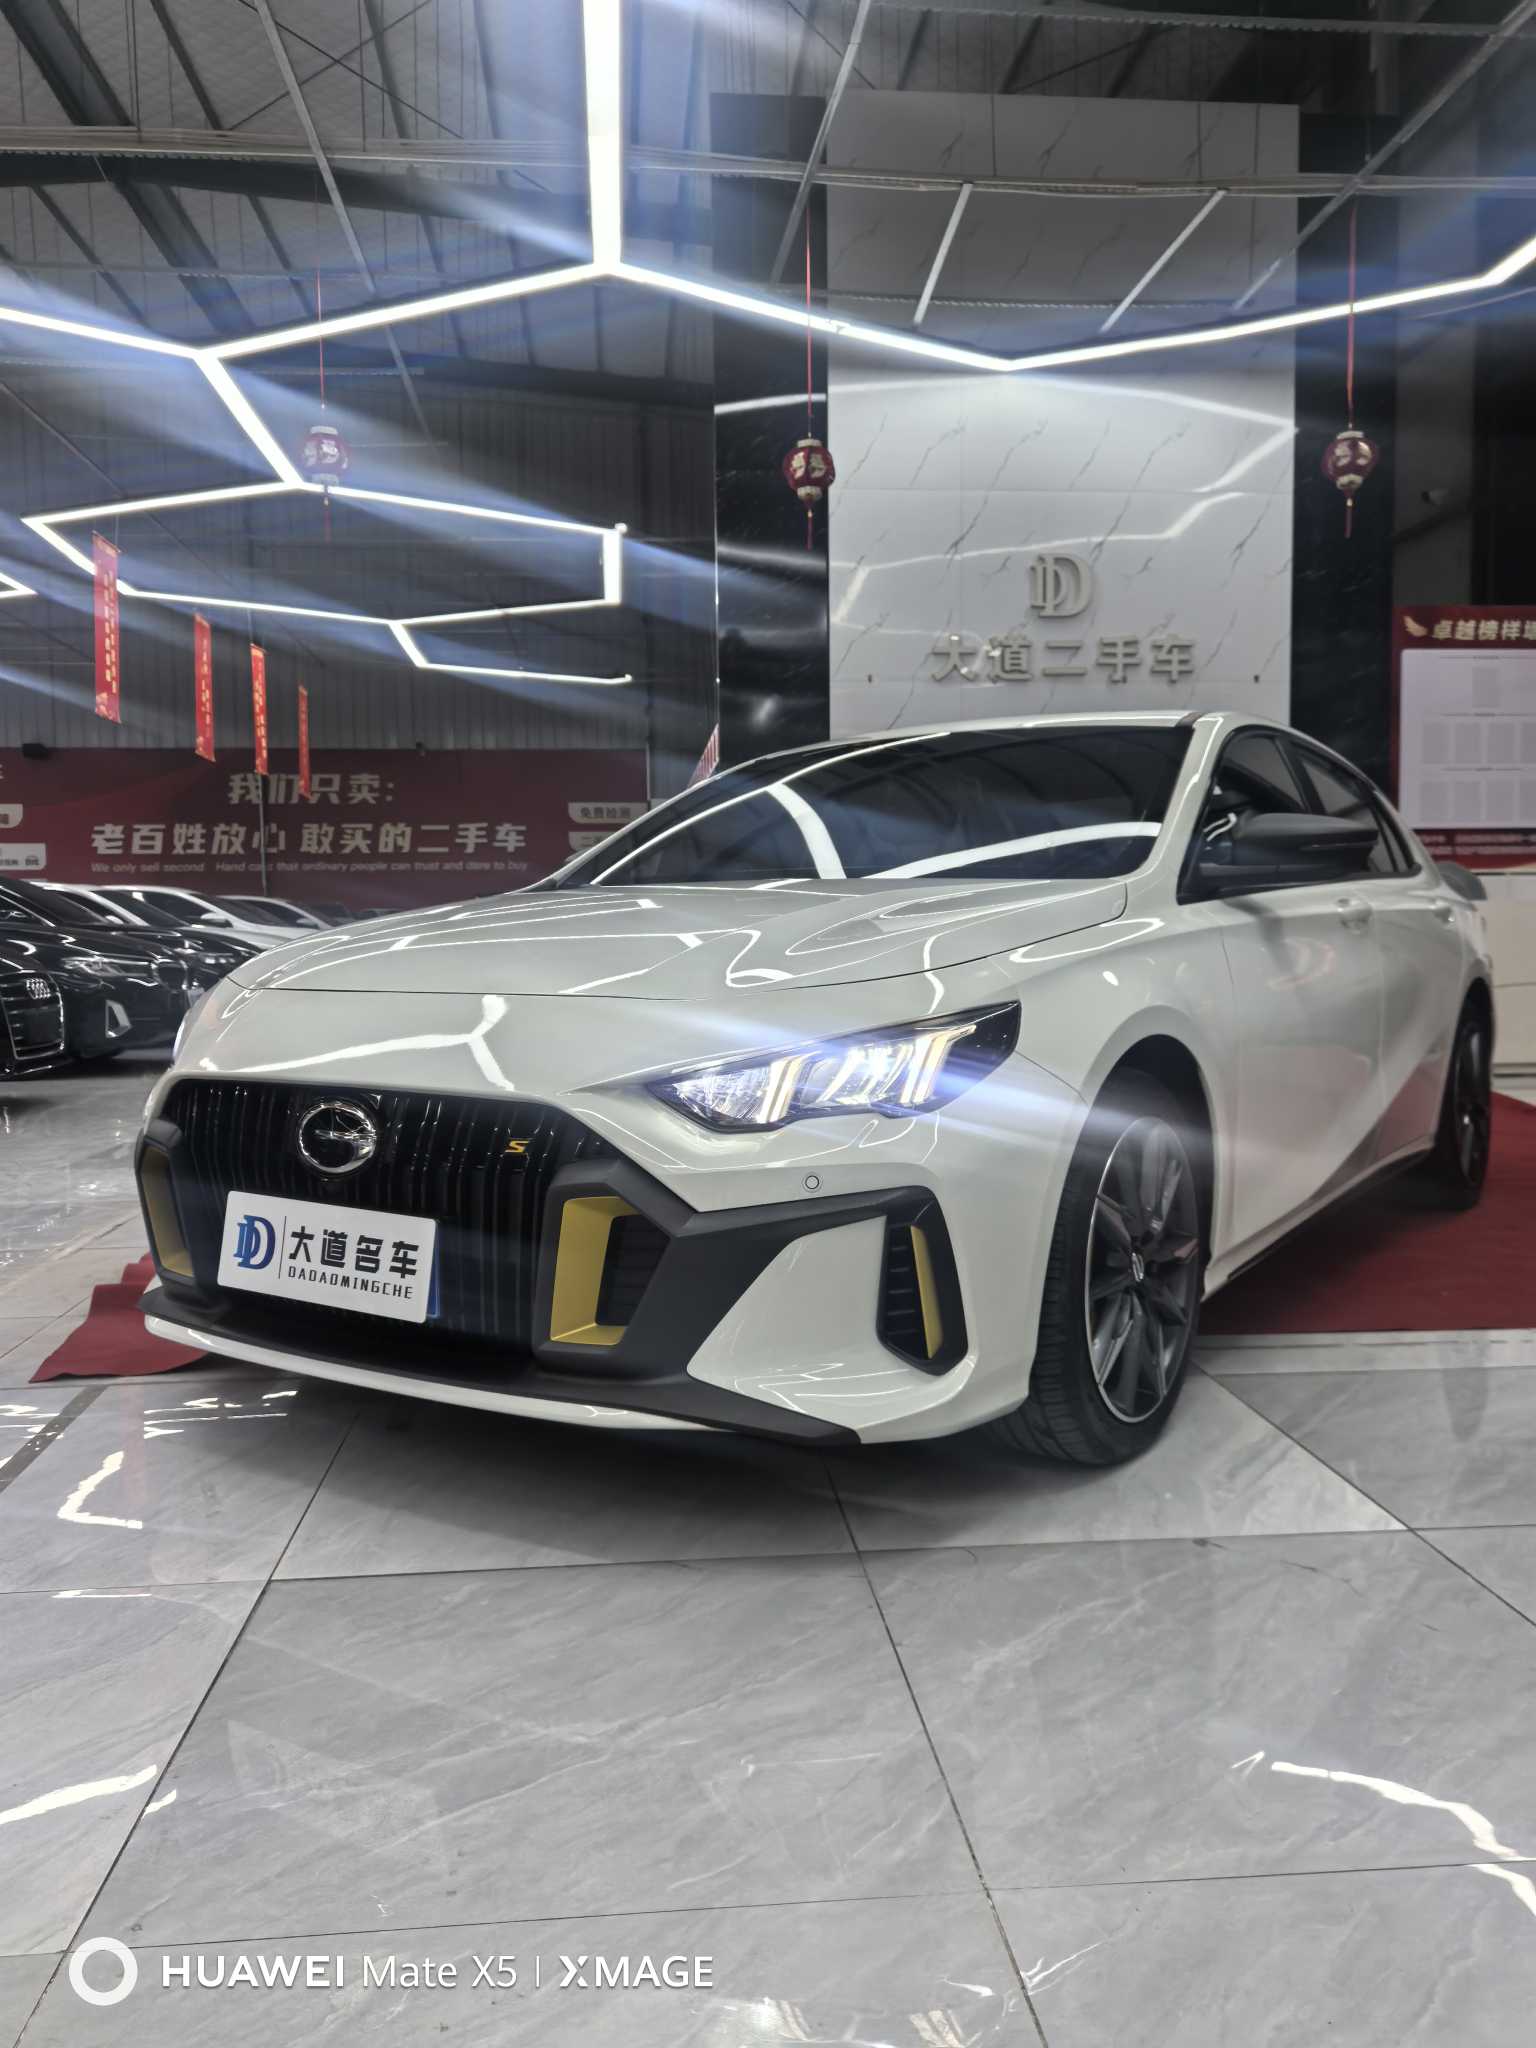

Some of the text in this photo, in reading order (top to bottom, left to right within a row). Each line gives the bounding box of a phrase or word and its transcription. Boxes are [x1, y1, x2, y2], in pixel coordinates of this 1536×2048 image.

[930, 632, 1195, 684] 大道二手车
[90, 822, 527, 855] 老百姓放心 敢买的二手车
[90, 863, 110, 873] We
[112, 862, 137, 875] only
[140, 862, 160, 873] sell
[162, 862, 205, 873] second
[216, 861, 246, 872] Hand
[275, 861, 299, 872] that
[302, 861, 347, 874] ordinary
[350, 863, 388, 874] people
[391, 863, 411, 871] can
[442, 861, 463, 871] and
[493, 861, 505, 870] to
[507, 861, 528, 873] buy
[289, 1226, 420, 1279] 大道名车
[288, 1265, 413, 1300] DADAOMINGCHE
